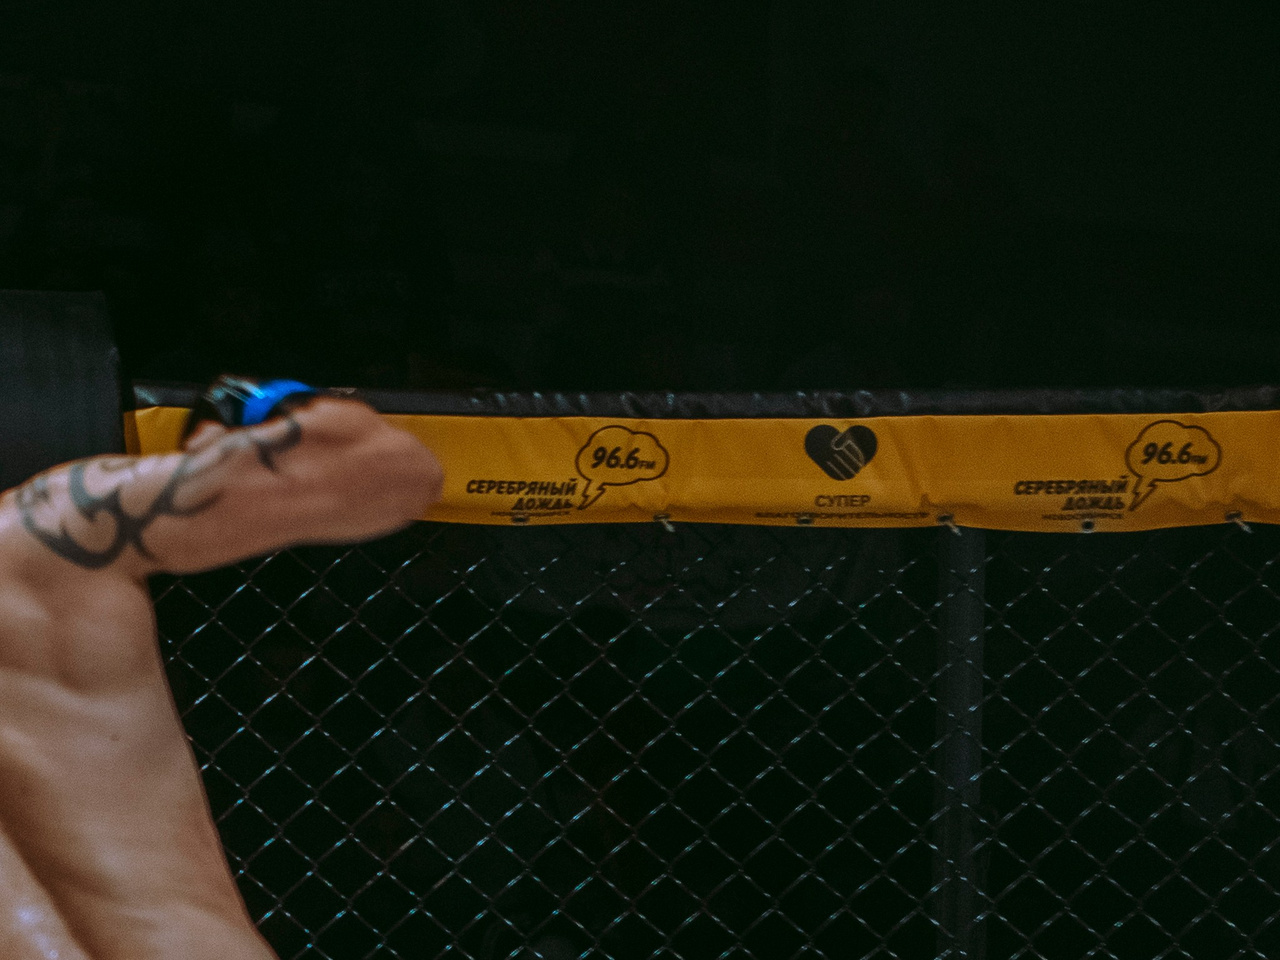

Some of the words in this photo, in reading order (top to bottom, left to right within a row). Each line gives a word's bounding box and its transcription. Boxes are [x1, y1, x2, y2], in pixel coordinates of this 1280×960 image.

[466, 478, 578, 496] СЕРЕБРЯНЫЙ
[1014, 475, 1128, 495] СЕРЕБРЯНЫЙ
[511, 497, 574, 511] ДОЖДЬ
[814, 494, 871, 508] СУПЕР
[1061, 496, 1125, 511] ДОЖДЬ
